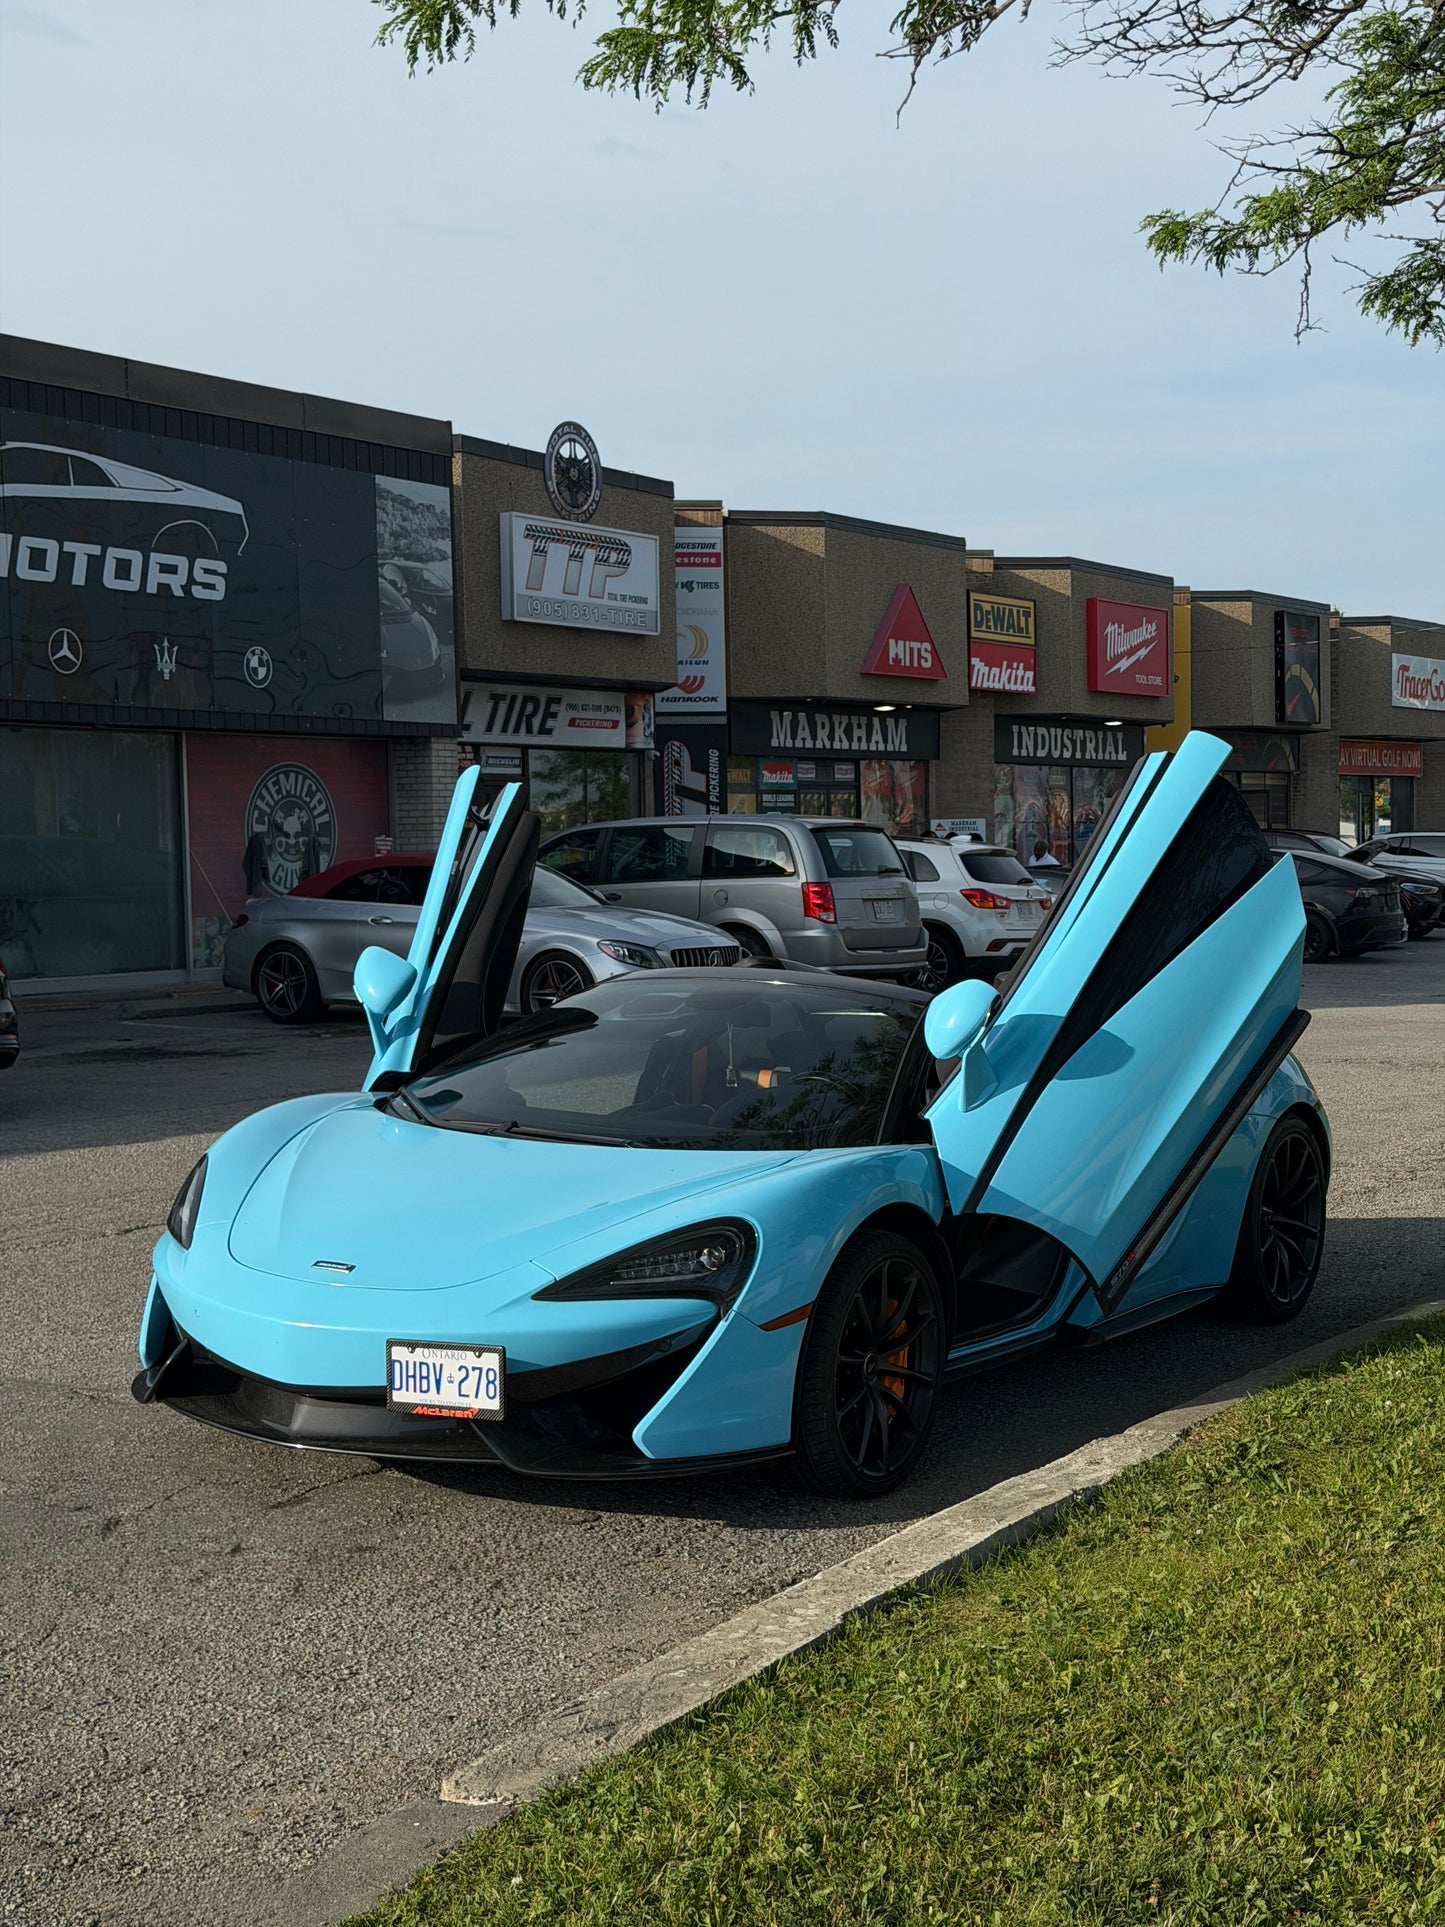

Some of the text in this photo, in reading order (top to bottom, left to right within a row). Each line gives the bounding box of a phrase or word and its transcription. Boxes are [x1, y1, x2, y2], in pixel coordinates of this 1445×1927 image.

[548, 424, 576, 454] TOTAL
[523, 524, 632, 599] TTP
[696, 581, 720, 590] TIRES
[527, 597, 648, 628] (905) 831-TIRE
[888, 638, 932, 668] MITS
[1104, 617, 1158, 662] Milwaukee
[1135, 674, 1163, 686] TOOL STORE
[484, 692, 563, 736] TIRE
[574, 719, 614, 728] PICKERING
[770, 711, 908, 752] MARKHAM
[1012, 724, 1127, 760] INDUSTRIAL
[1350, 748, 1382, 767] VIRTUAL
[1382, 750, 1400, 767] GOLF
[1401, 751, 1421, 768] NOW!
[708, 749, 720, 803] PICKERING
[252, 771, 331, 833] CHEMICAL
[421, 1348, 467, 1361] ONTARIO
[391, 1359, 497, 1400] DHBV 278
[412, 1406, 478, 1419] McLaren
